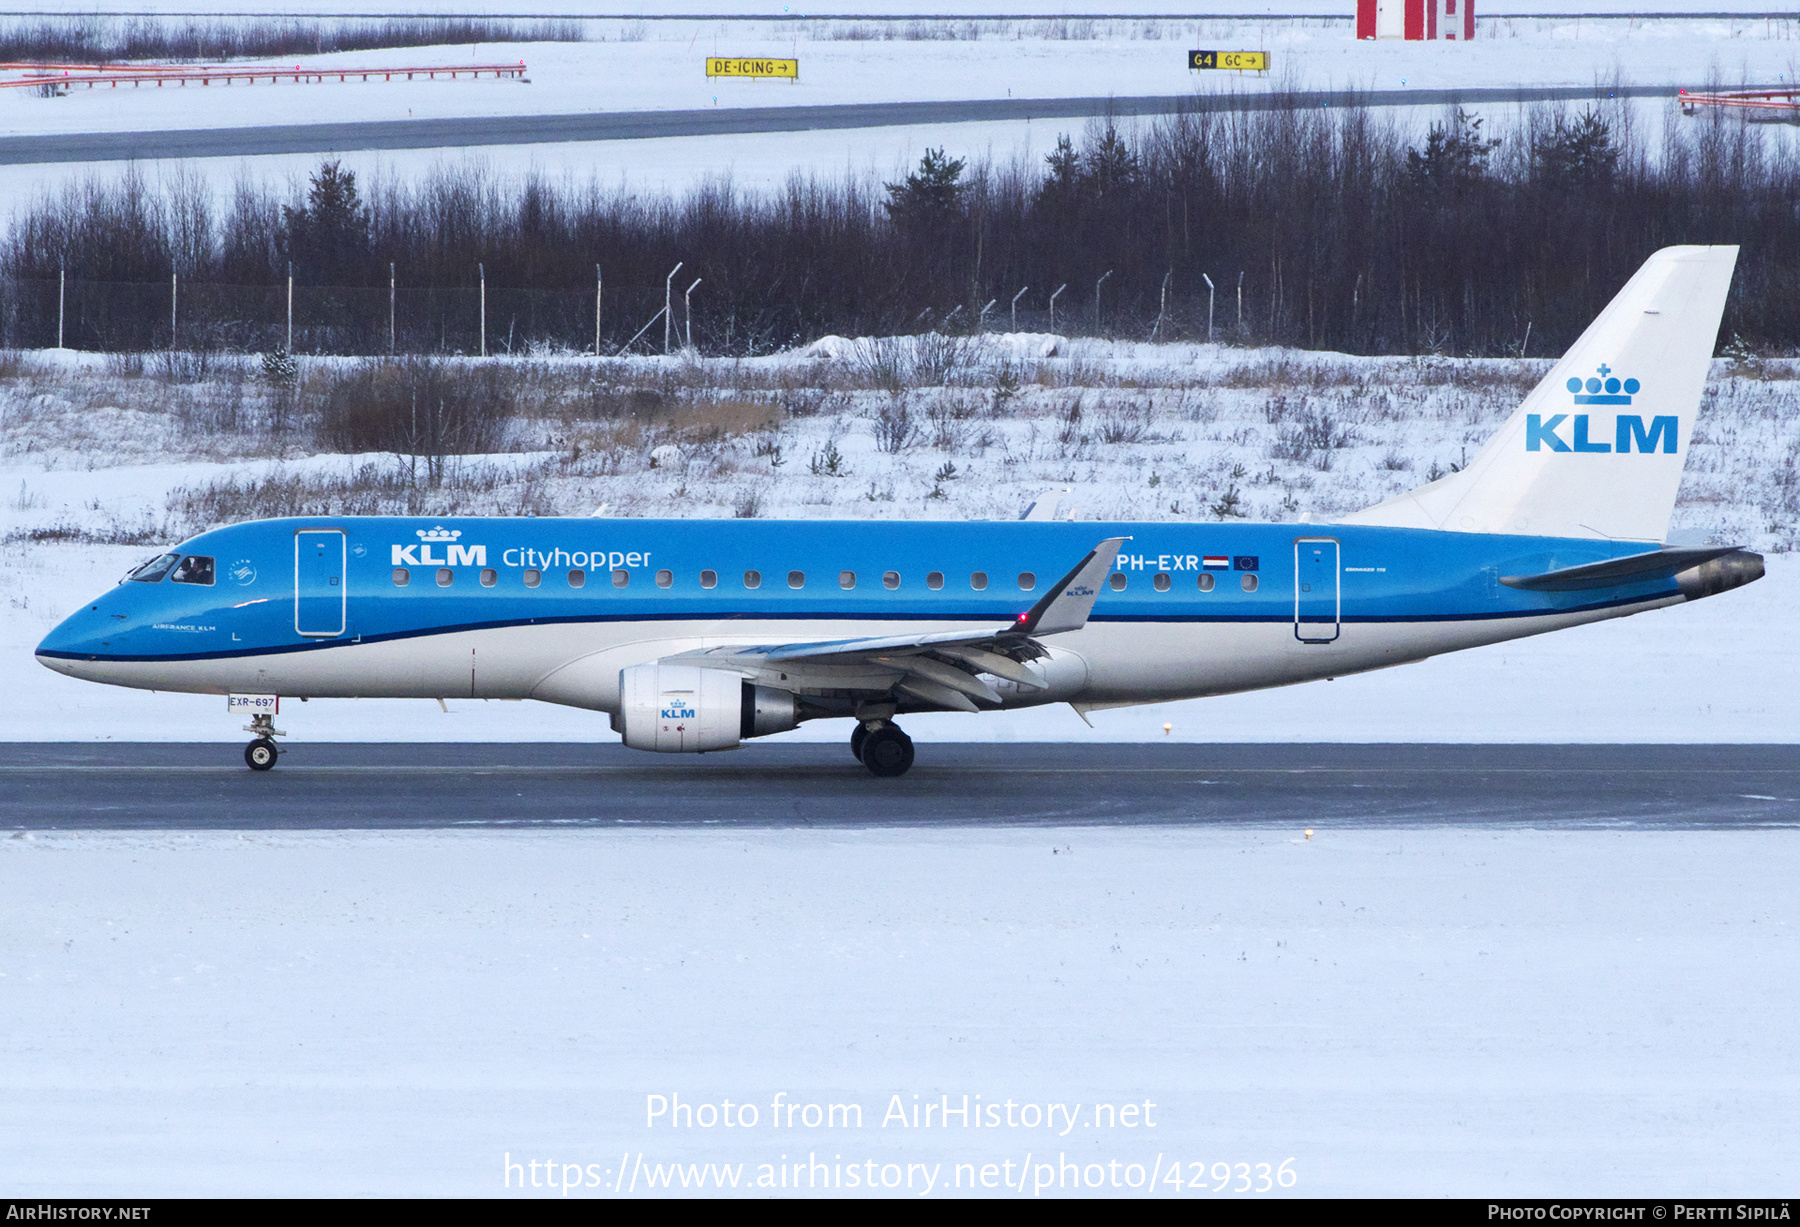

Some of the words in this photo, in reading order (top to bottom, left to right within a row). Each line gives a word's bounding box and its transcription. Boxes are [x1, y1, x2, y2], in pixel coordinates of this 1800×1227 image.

[714, 60, 774, 74] DE-ICING
[1194, 54, 1213, 66] G4
[1225, 55, 1241, 66] GC
[1525, 413, 1679, 454] KLM
[391, 544, 487, 566] KLM
[503, 547, 651, 572] Cityhopper
[1116, 554, 1199, 571] PH-EXR
[230, 697, 274, 707] EXR-697
[661, 709, 695, 718] KLM
